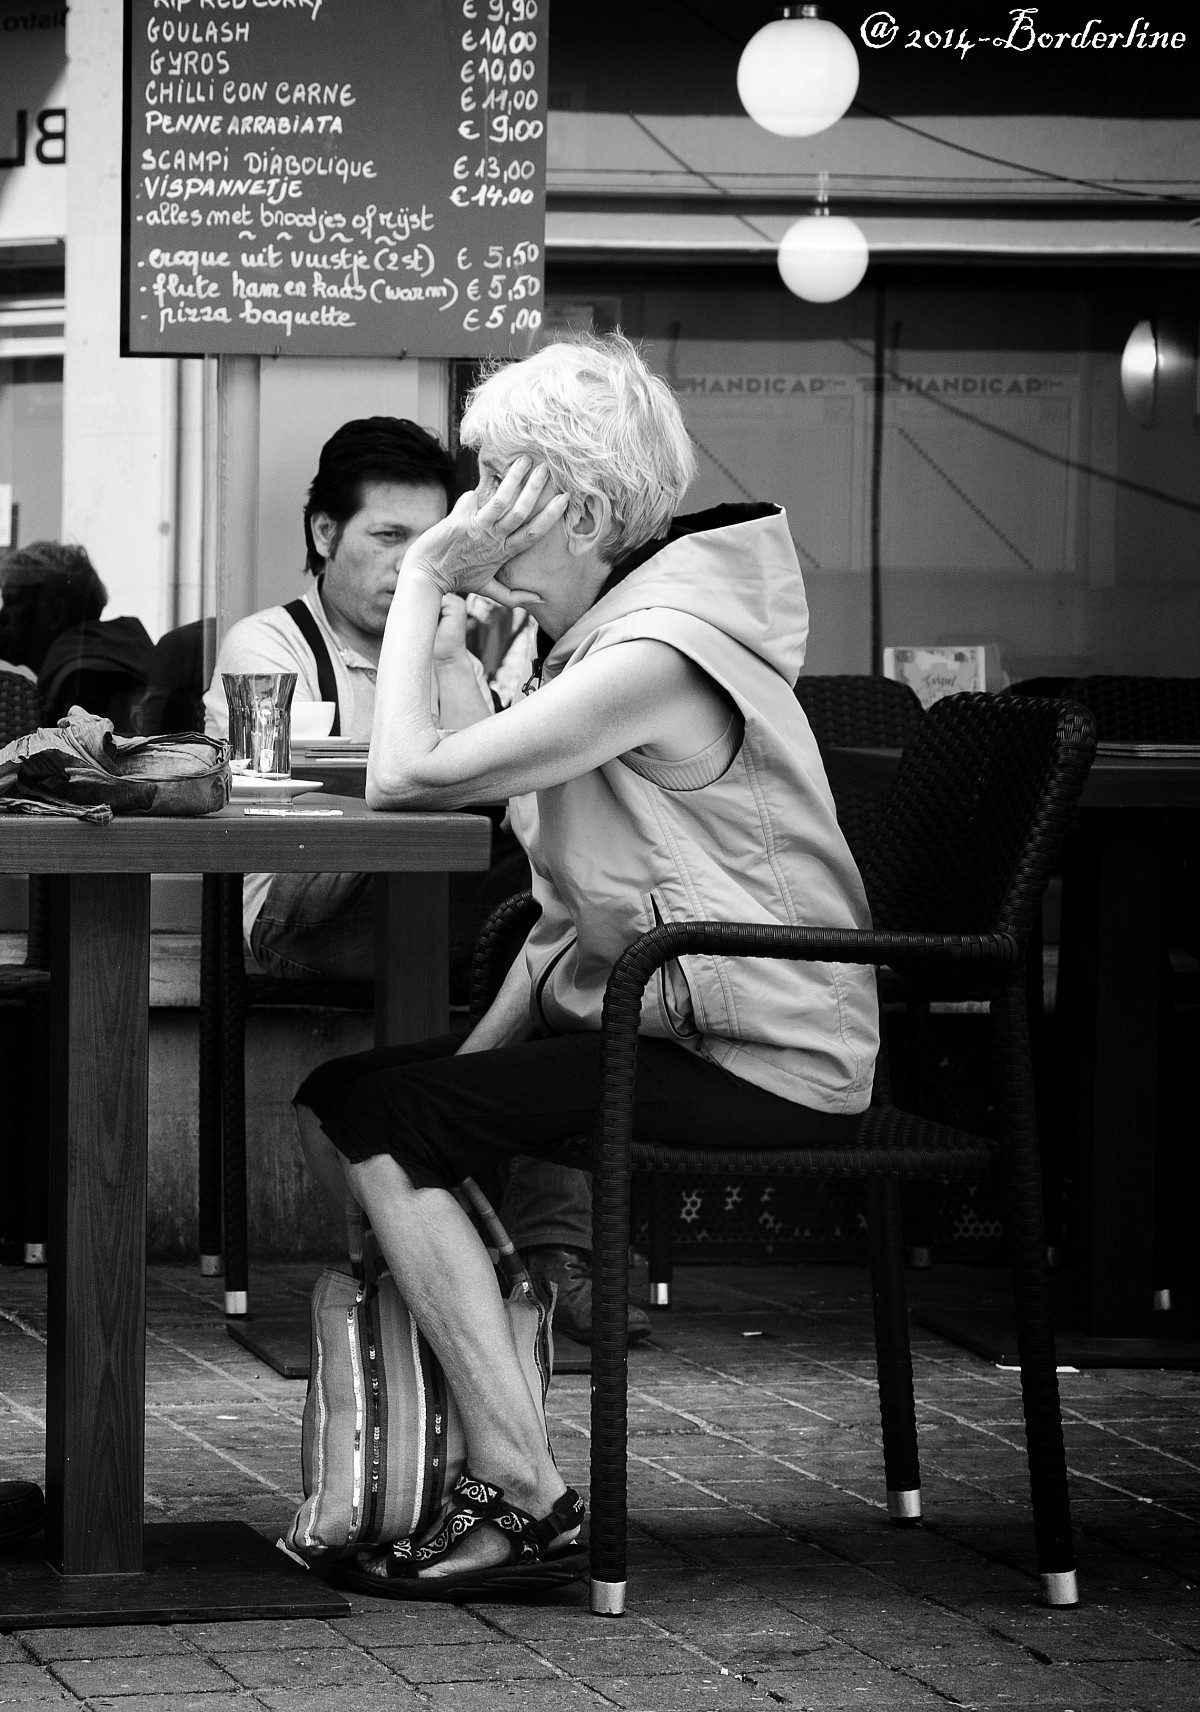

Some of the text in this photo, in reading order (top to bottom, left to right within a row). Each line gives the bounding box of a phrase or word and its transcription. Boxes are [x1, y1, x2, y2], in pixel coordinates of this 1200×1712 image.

[147, 17, 250, 43] GOULASH
[150, 49, 230, 75] GYROS
[223, 81, 268, 104] CON
[276, 81, 357, 107] CARNE
[145, 110, 223, 135] PENNE
[206, 203, 254, 226] met
[241, 244, 284, 268] uit
[152, 272, 222, 308] flute
[232, 270, 282, 299] ham
[283, 280, 307, 298] en
[159, 300, 233, 333] pizza
